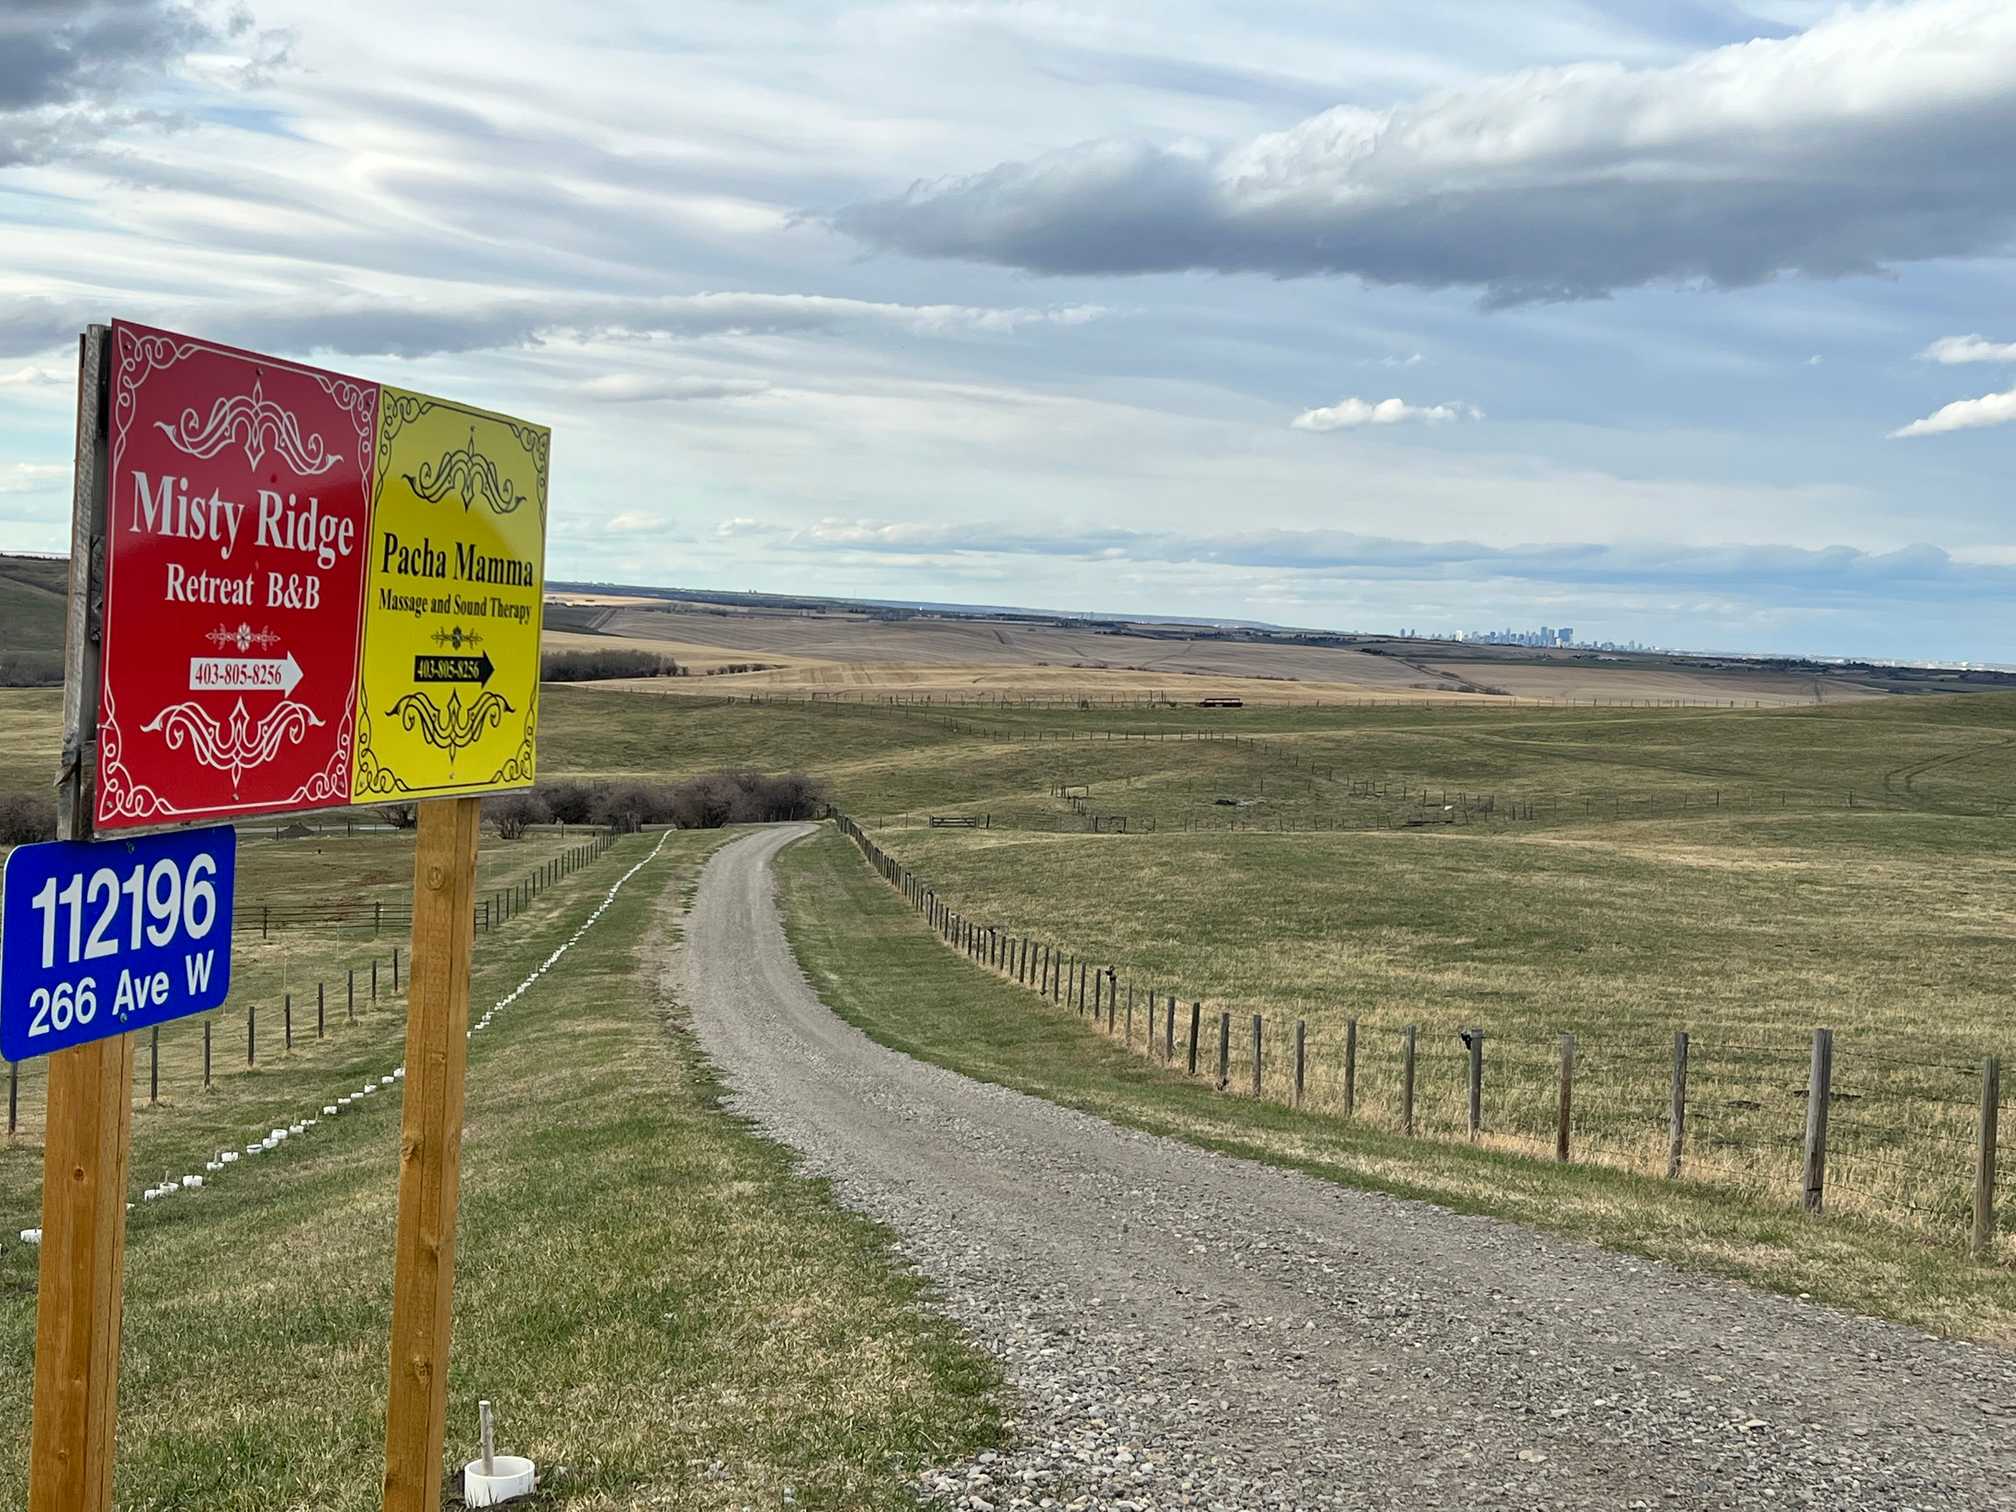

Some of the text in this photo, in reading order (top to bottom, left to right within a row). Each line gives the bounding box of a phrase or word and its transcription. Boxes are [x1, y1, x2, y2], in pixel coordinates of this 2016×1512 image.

[128, 470, 354, 569] Misty Ridge
[381, 531, 534, 587] Pacha Mamma
[164, 562, 320, 610] Retreat B&B
[378, 587, 532, 625] Massage and Sound Therapy
[195, 663, 282, 685] 403-805-8256
[417, 659, 480, 679] 403-805-8256
[32, 853, 217, 969] 112196
[28, 949, 215, 1038] 266 Ave W
